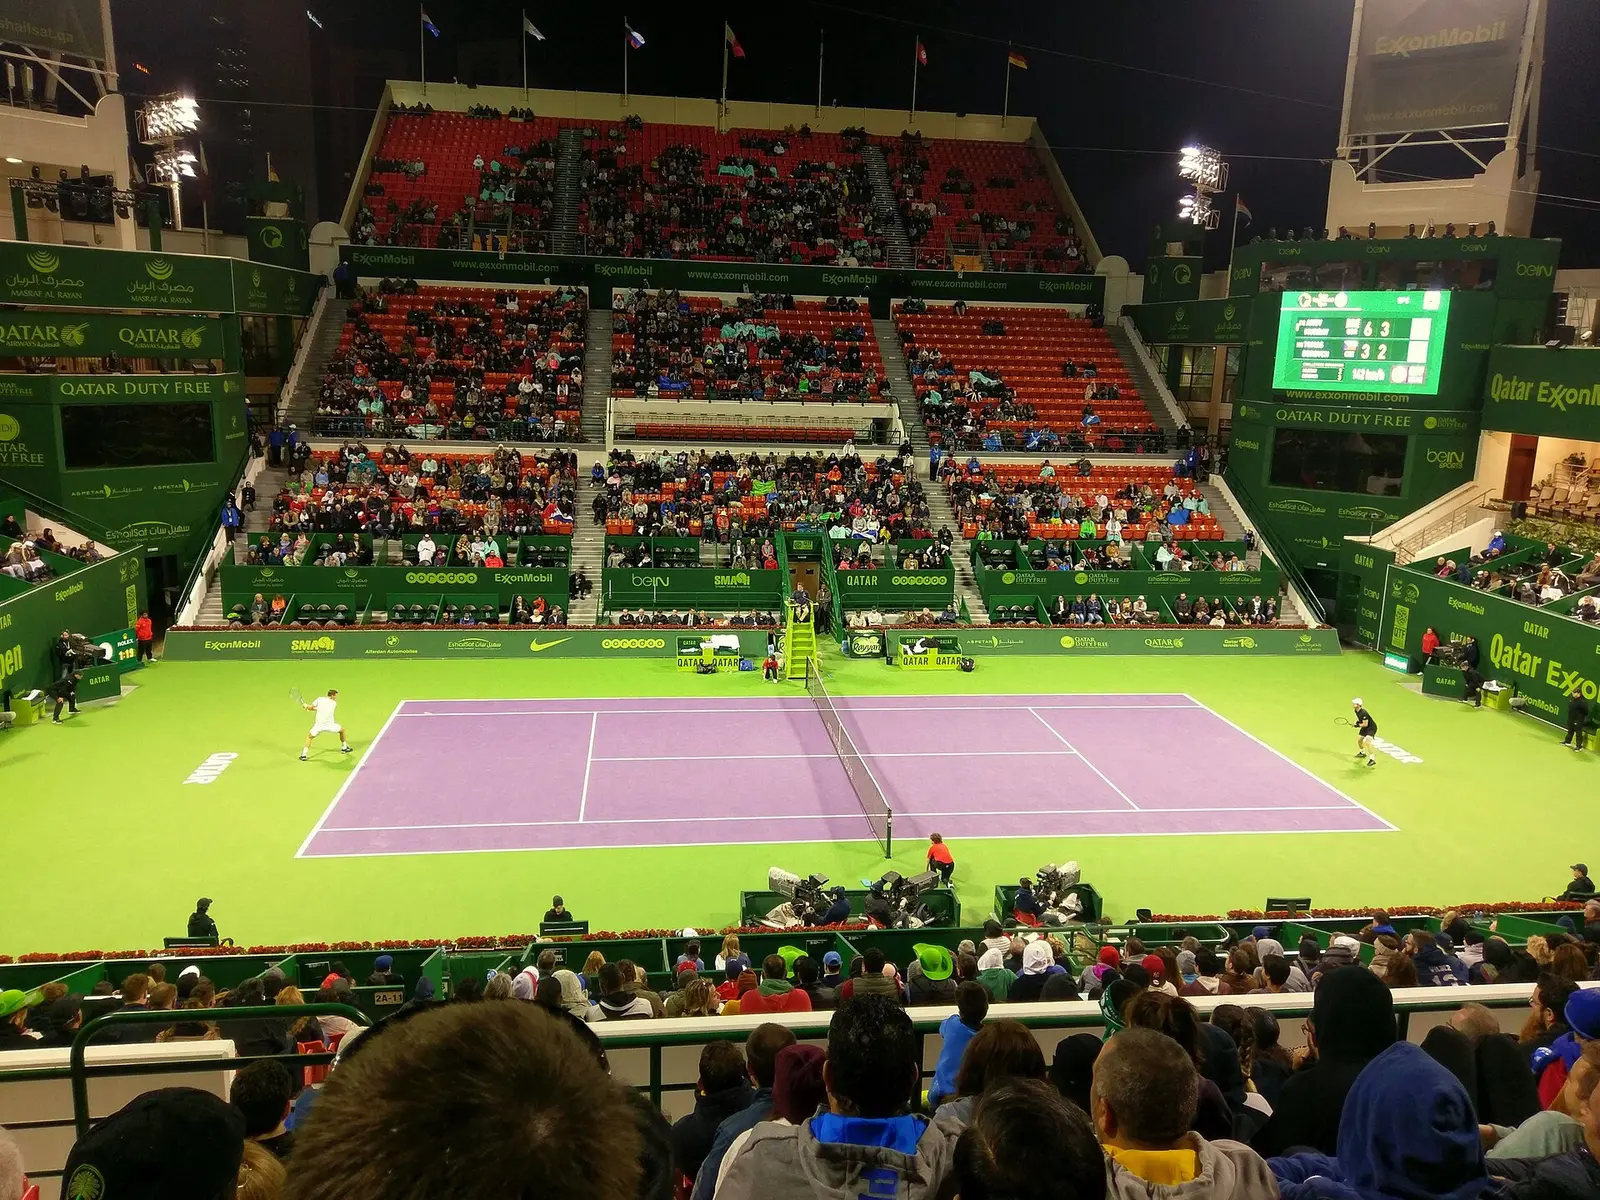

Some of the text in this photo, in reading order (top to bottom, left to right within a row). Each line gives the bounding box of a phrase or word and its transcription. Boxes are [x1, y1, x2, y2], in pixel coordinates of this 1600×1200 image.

[1375, 20, 1506, 58] ExxonMobil
[1362, 102, 1498, 123] www.exxonmobil.com
[352, 252, 415, 266] ExxonMobil
[452, 258, 559, 273] www.exxonmobil.com
[594, 262, 653, 277] ExxonMobil
[687, 269, 789, 284] www.exxonmobil.com
[822, 272, 878, 287] ExxonMobil
[910, 277, 1007, 291] www.exxonmobil.com
[1038, 279, 1092, 293] ExxonMobil
[1363, 320, 1373, 337] 6
[1380, 321, 1390, 337] 3
[119, 328, 179, 345] QATAR
[1361, 343, 1370, 359] 3
[1377, 343, 1387, 360] 2
[60, 381, 212, 396] QATAR DUTY FREE
[1491, 373, 1534, 402] Qatar
[1286, 390, 1409, 404] www.exxonmobil.com
[1276, 409, 1323, 421] QATAR
[1329, 412, 1371, 425] DUTY
[1374, 414, 1412, 427] FREE
[12, 453, 44, 463] FREE
[1427, 448, 1464, 463] beIN
[1354, 553, 1374, 569] QATAR
[406, 572, 478, 584] ooredoo
[494, 572, 553, 585] ExxonMobil
[631, 573, 669, 587] beIN
[847, 576, 878, 586] QATAR
[892, 575, 947, 586] ooredoo
[55, 581, 84, 601] ExxonMobil
[1448, 596, 1485, 615] ExxonMobil
[1523, 621, 1549, 639] QATAR
[117, 638, 133, 647] ROLEX
[204, 640, 261, 651] ExxonMobil
[601, 637, 665, 649] ooredoo
[1144, 638, 1172, 647] QATAR
[904, 656, 962, 665] QATAR QATAR
[1490, 633, 1542, 678] Qatar
[89, 675, 110, 685] QATAR
[1436, 677, 1456, 686] QATAR
[376, 994, 403, 1003] 2A-11
